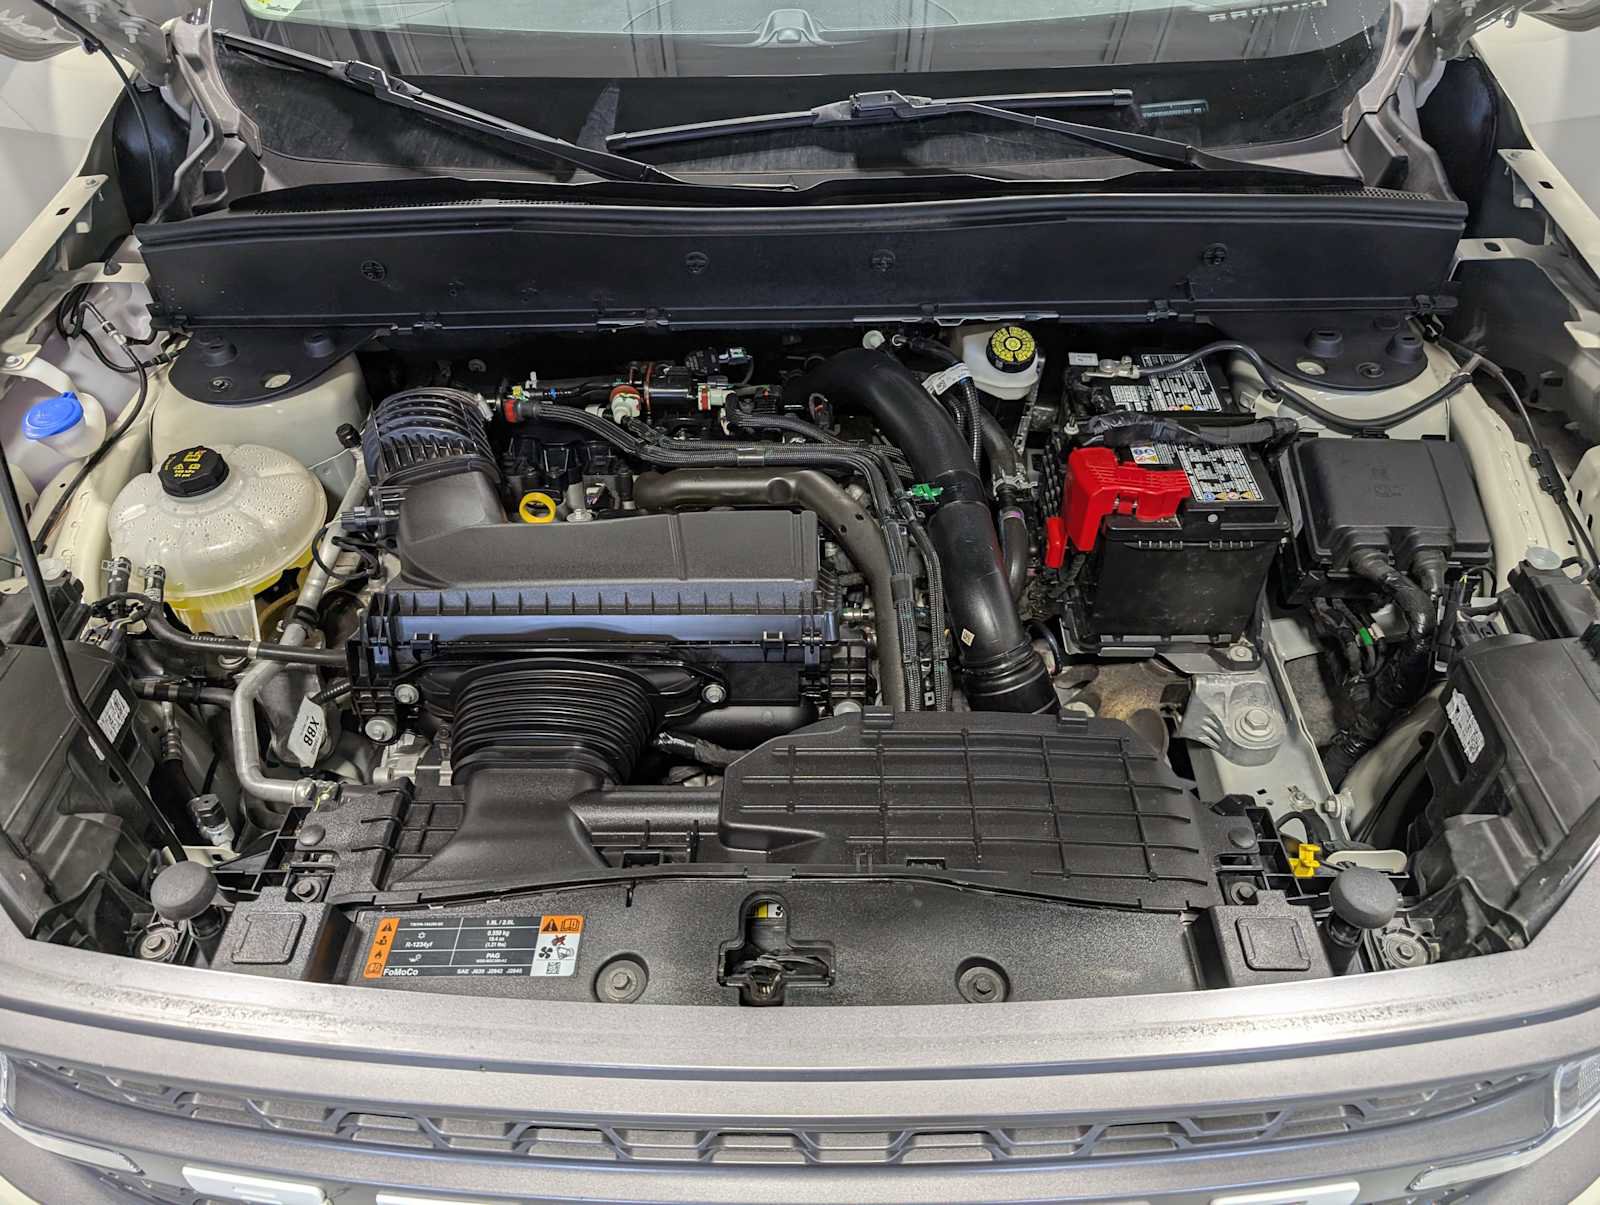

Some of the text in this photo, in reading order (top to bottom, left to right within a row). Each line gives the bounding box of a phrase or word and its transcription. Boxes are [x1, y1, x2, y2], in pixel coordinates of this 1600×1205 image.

[303, 715, 320, 746] XBB
[405, 941, 433, 949] R-1234yf
[383, 968, 419, 976] FoMoCo
